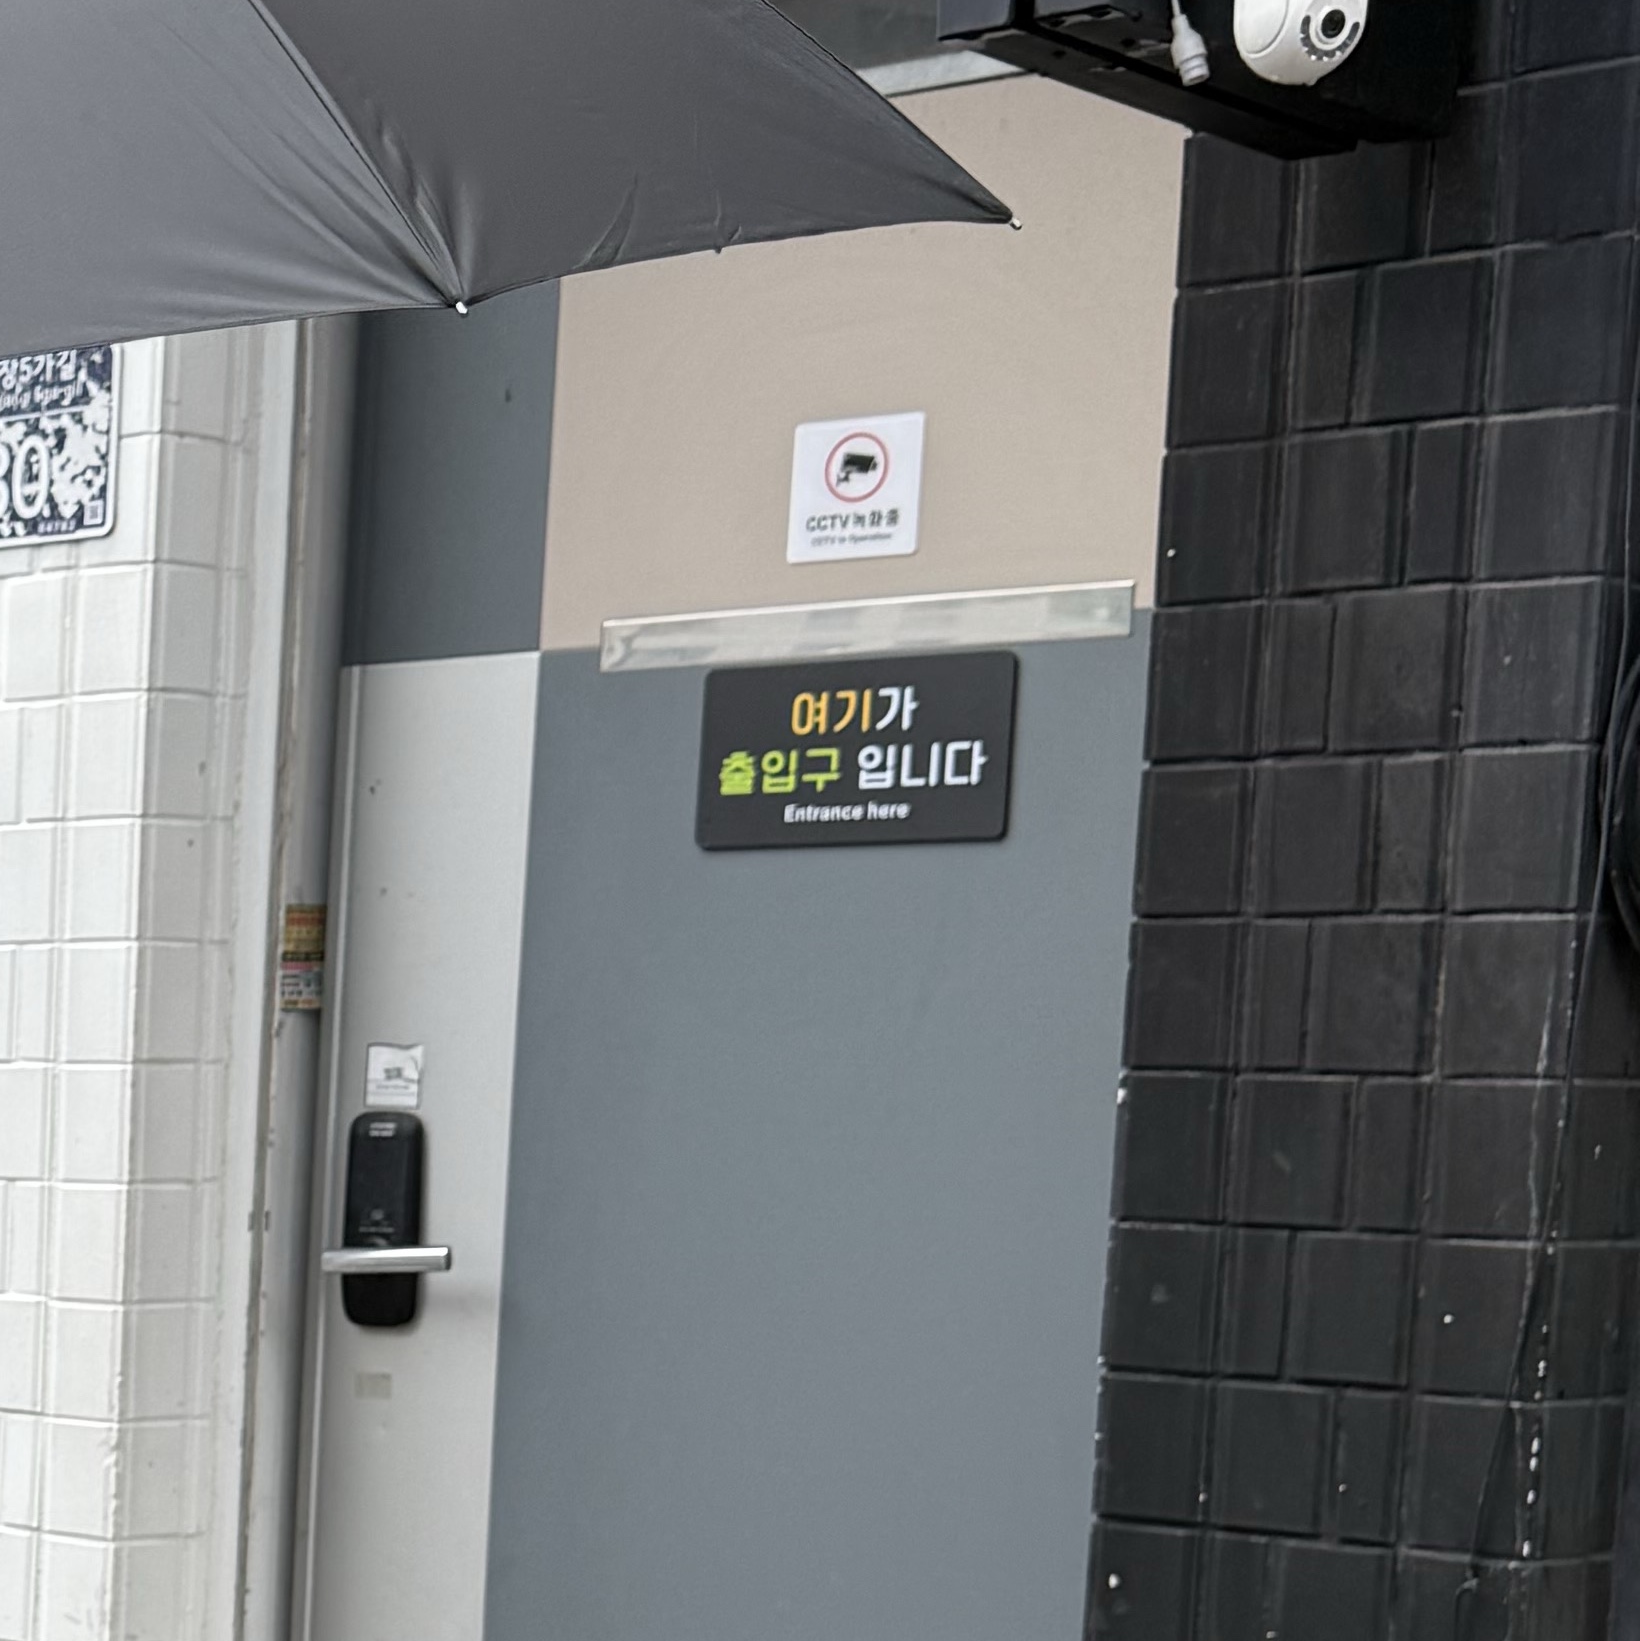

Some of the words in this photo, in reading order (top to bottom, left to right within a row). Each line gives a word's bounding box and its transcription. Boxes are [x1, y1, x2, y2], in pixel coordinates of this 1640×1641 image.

[791, 686, 920, 735] 여기가
[719, 748, 842, 796] 출입구
[858, 740, 989, 790] 입니다
[784, 803, 864, 823] Entrance
[866, 801, 910, 821] here
